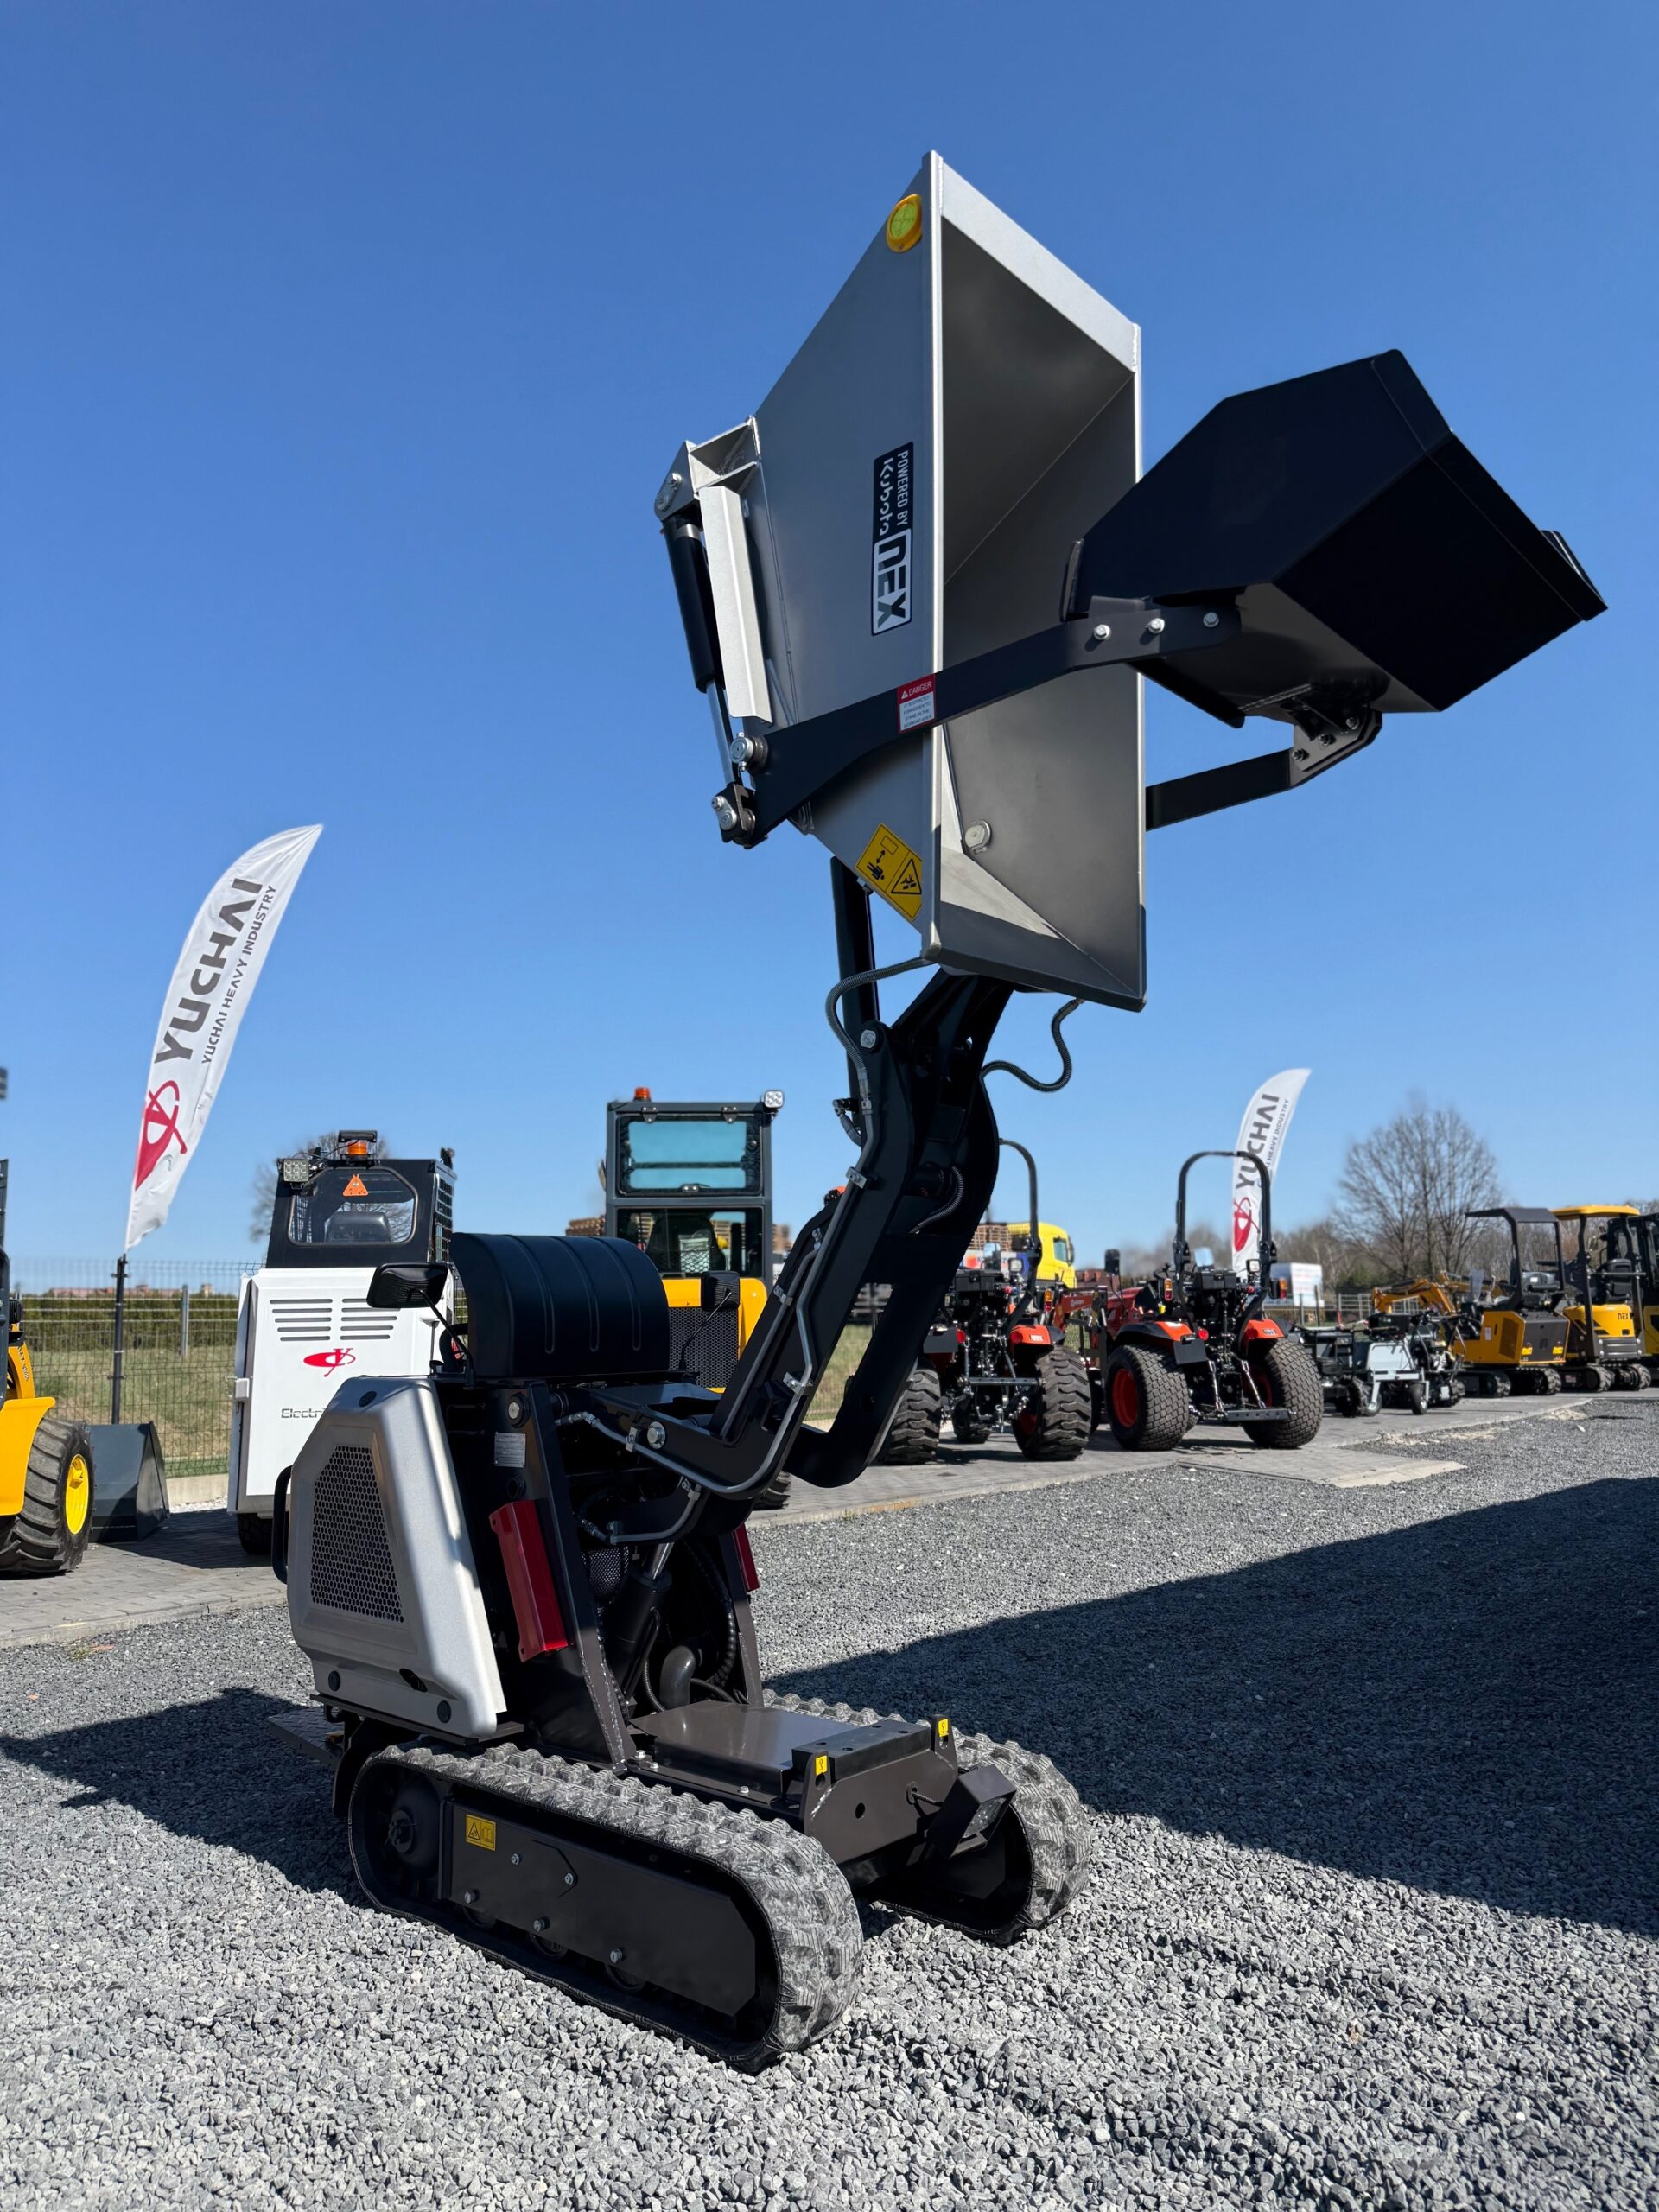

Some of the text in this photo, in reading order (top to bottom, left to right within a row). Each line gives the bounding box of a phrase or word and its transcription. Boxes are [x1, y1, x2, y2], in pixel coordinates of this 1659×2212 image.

[880, 457, 893, 537] Kubota
[897, 450, 909, 526] POWERED BY
[908, 681, 932, 696] DANGER
[154, 878, 263, 1064] YUCHAI
[201, 885, 276, 1064] YUCHAI HEAVY INDUSTRY
[1274, 1098, 1290, 1135] INDUSTRY
